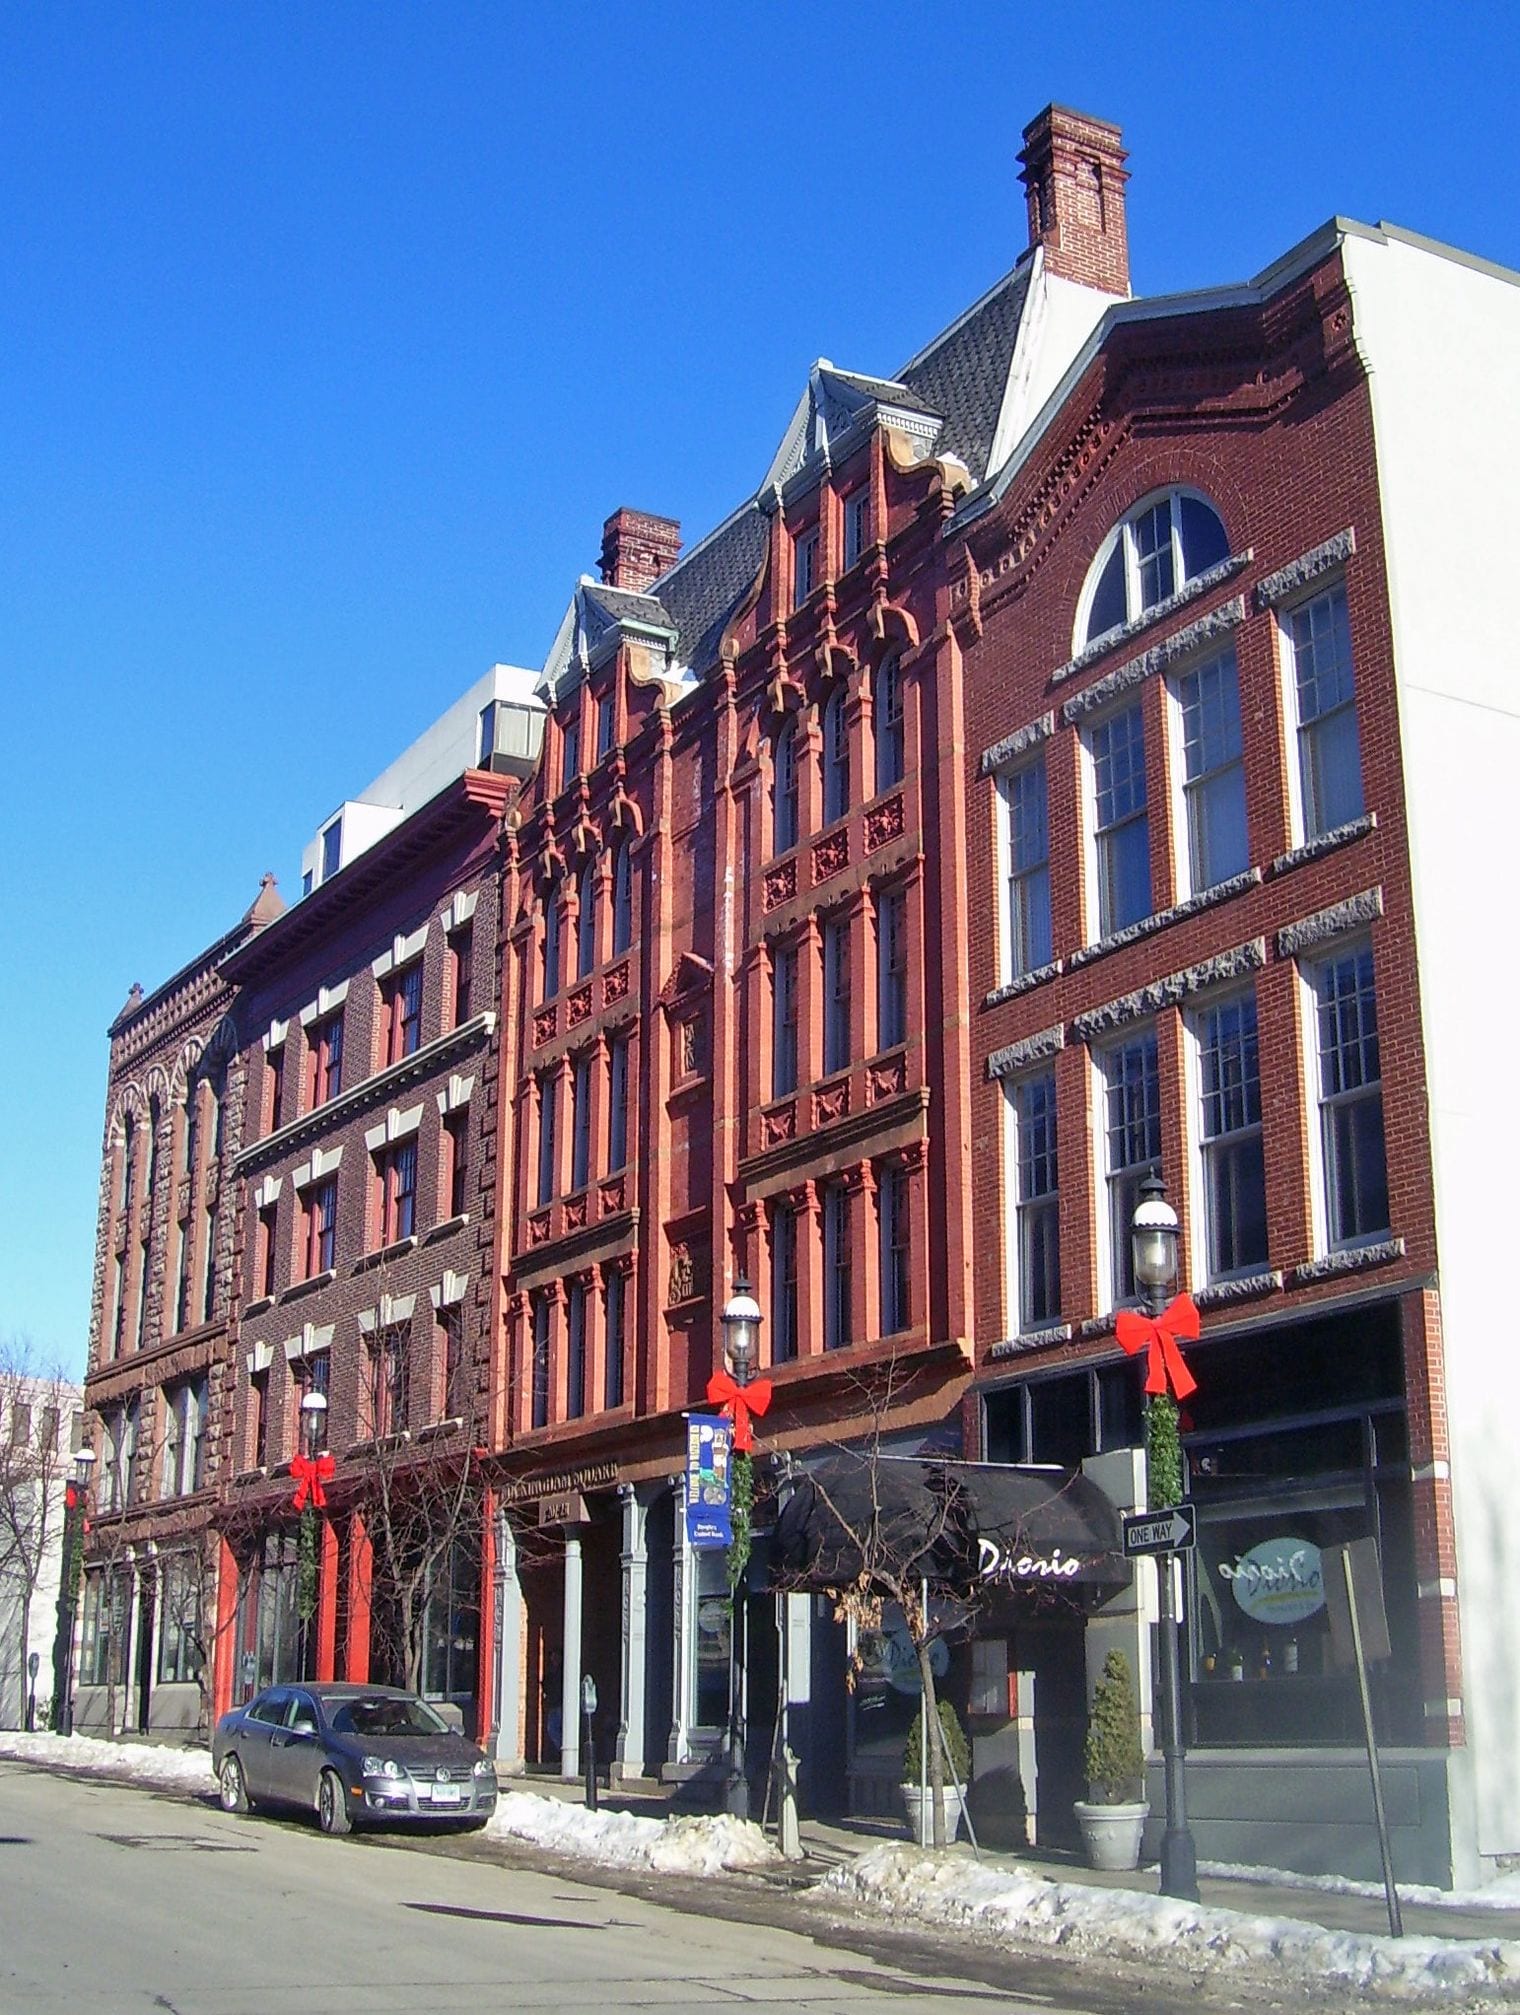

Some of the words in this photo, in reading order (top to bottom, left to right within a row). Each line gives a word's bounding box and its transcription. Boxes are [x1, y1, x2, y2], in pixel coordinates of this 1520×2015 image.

[1130, 1526, 1150, 1545] ONE
[1151, 1521, 1173, 1541] WAY
[977, 1538, 1081, 1577] Diorio
